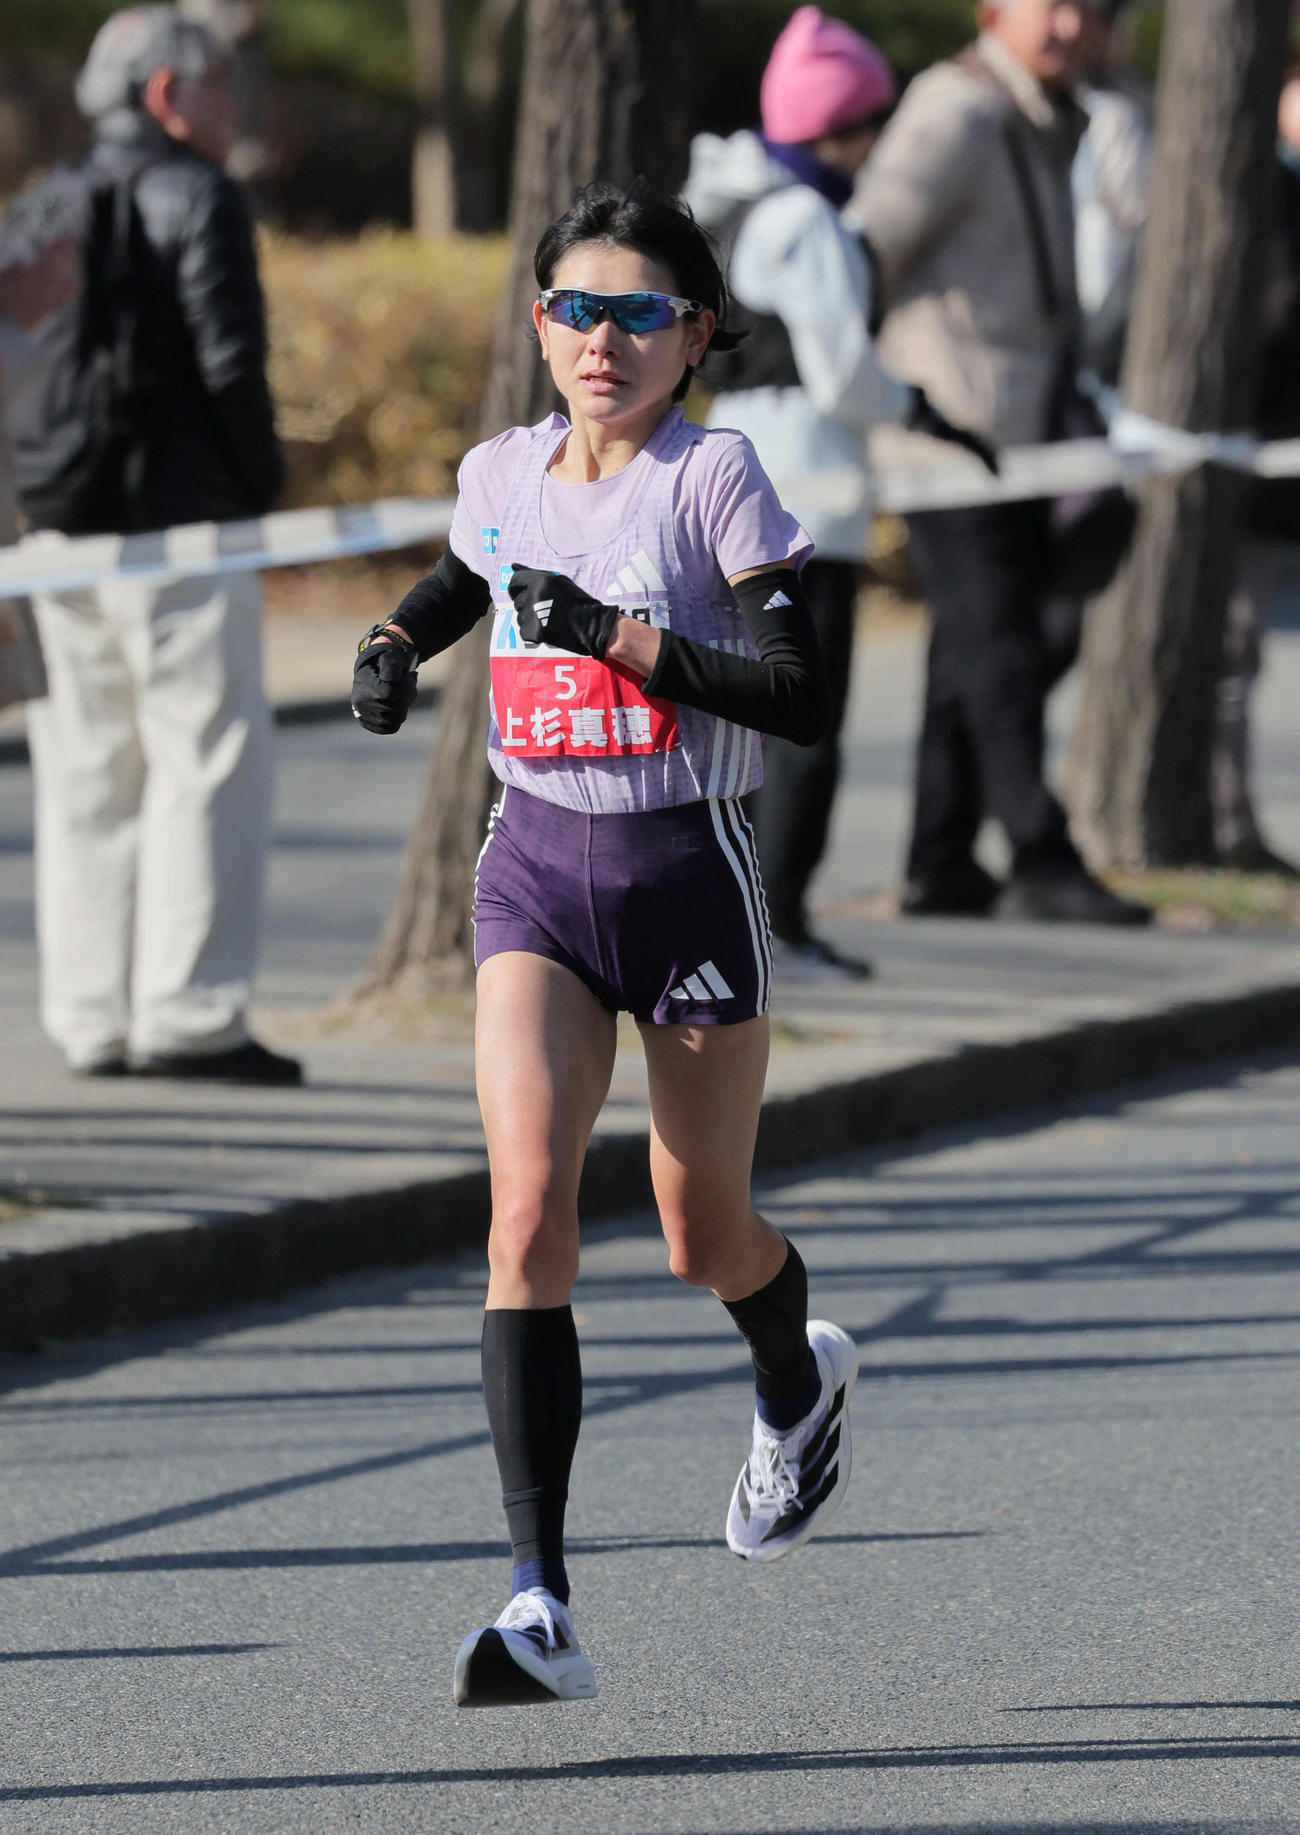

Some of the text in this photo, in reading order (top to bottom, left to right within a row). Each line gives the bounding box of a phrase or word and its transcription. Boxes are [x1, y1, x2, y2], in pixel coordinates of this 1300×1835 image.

[554, 665, 577, 700] 5
[501, 705, 653, 748] 上杉真穂
